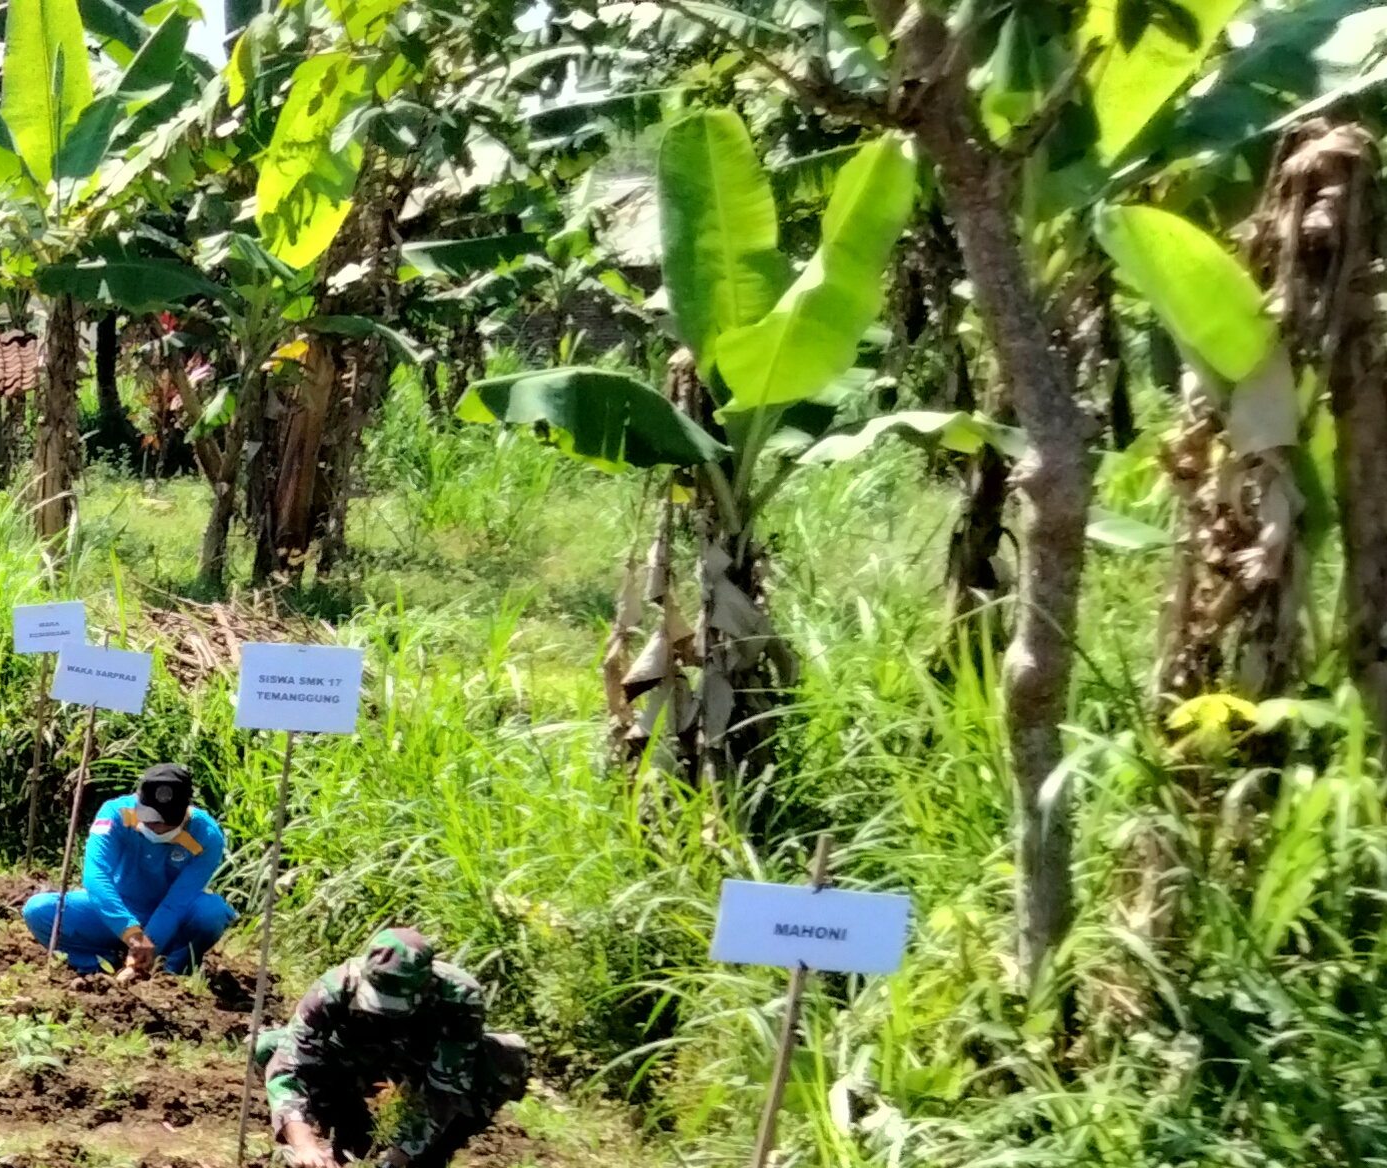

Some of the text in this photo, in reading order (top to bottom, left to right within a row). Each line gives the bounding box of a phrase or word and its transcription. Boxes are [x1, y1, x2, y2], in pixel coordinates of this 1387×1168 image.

[67, 664, 137, 682] WAKA SARPRAS
[258, 674, 343, 687] SISWA SMK 17
[256, 691, 341, 704] TEMANGGUNG
[774, 923, 848, 941] MAHONI
